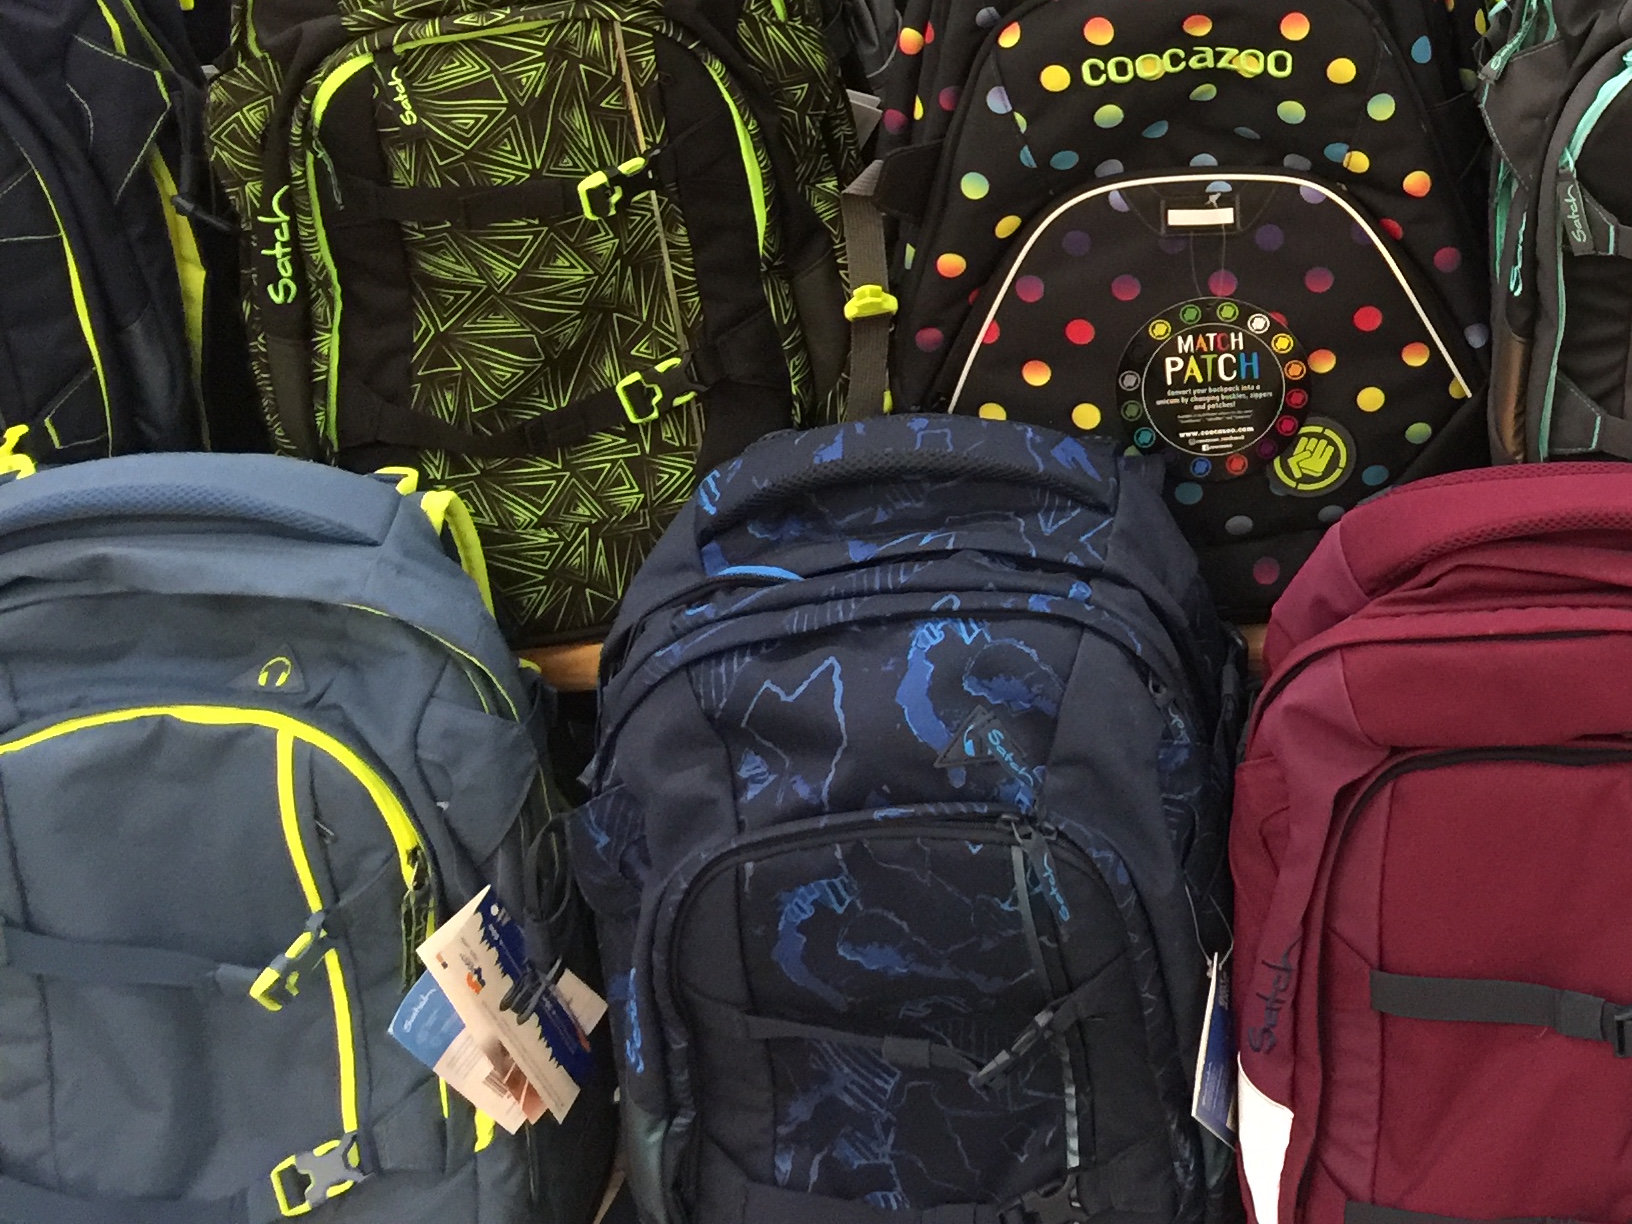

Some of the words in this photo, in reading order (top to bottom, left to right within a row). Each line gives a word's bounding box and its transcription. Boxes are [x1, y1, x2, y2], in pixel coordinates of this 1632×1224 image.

[1081, 46, 1293, 87] coocazoo
[388, 66, 418, 126] Satch
[1566, 183, 1588, 244] Satch
[257, 184, 298, 304] Satch
[1177, 331, 1244, 354] MATCH
[1164, 351, 1260, 386] PATCH
[1167, 388, 1192, 396] Convert
[1192, 388, 1208, 396] your
[1208, 385, 1240, 394] backpack
[1181, 395, 1189, 404] by
[1190, 394, 1220, 403] changing
[1250, 391, 1273, 399] zippers
[1193, 403, 1206, 411] and
[987, 728, 1034, 787] Satch
[1043, 852, 1071, 922] Satch
[1248, 936, 1301, 1055] Satch
